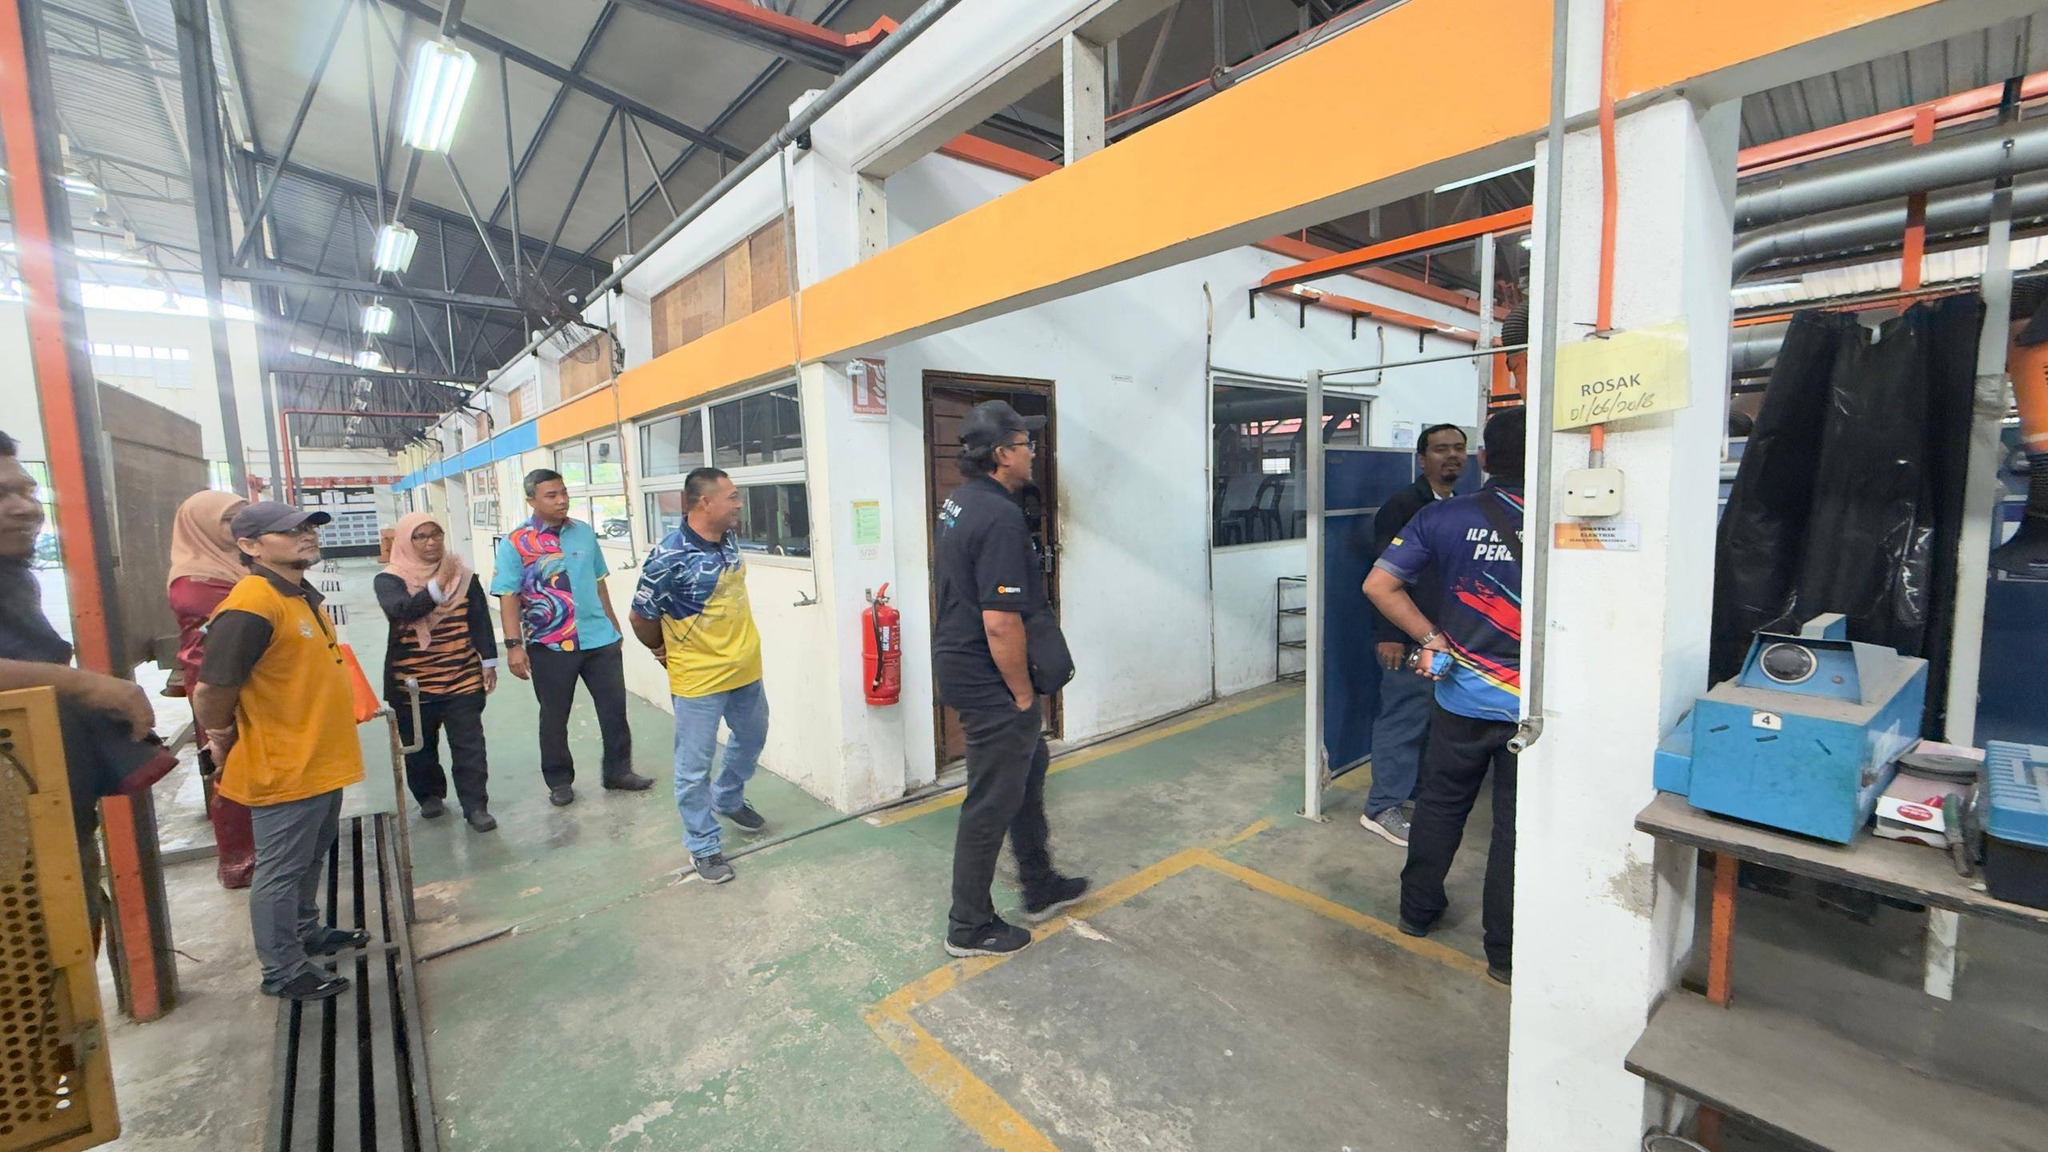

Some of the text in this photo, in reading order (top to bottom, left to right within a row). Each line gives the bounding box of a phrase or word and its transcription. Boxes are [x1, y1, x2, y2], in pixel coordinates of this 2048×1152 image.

[1581, 373, 1641, 397] ROSAK
[1569, 391, 1655, 422] 01/06/2018
[1465, 528, 1488, 541] ILP
[1473, 544, 1516, 561] PERL
[1761, 715, 1770, 725] 4
